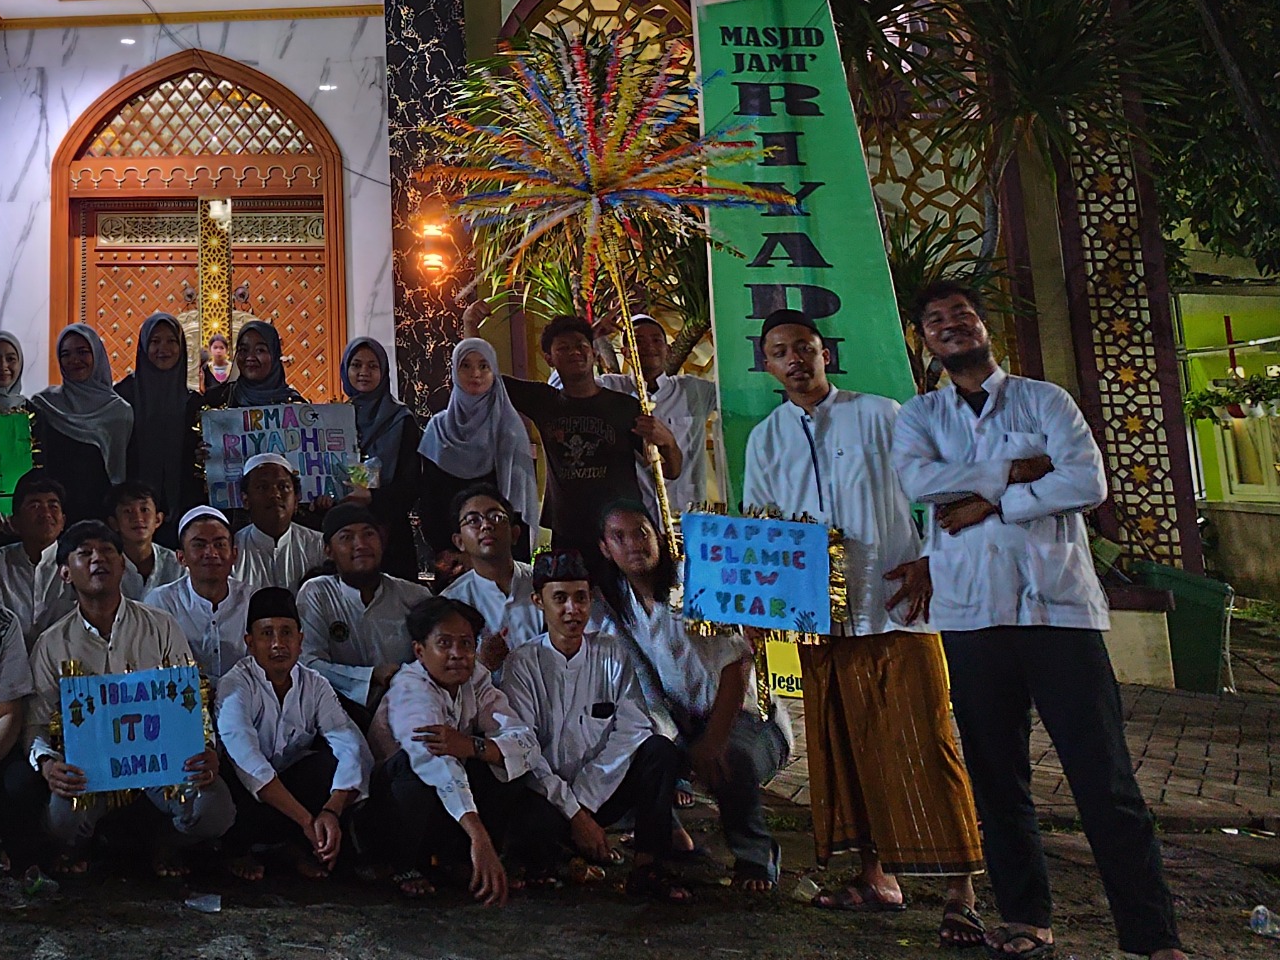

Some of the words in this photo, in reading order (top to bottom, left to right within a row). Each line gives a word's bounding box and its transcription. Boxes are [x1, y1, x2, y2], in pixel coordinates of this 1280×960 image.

[720, 27, 824, 47] MASJID
[243, 406, 300, 432] IRMA
[223, 428, 346, 460] RIYADHIS
[224, 452, 349, 481] SIHIN
[701, 522, 805, 546] HAPPY
[700, 543, 806, 569] ISLAMIC
[721, 568, 779, 586] NEW
[715, 591, 787, 619] YEAR
[100, 680, 166, 705] ISLAM
[112, 713, 161, 744] ITU
[110, 753, 168, 778] DAMAI
